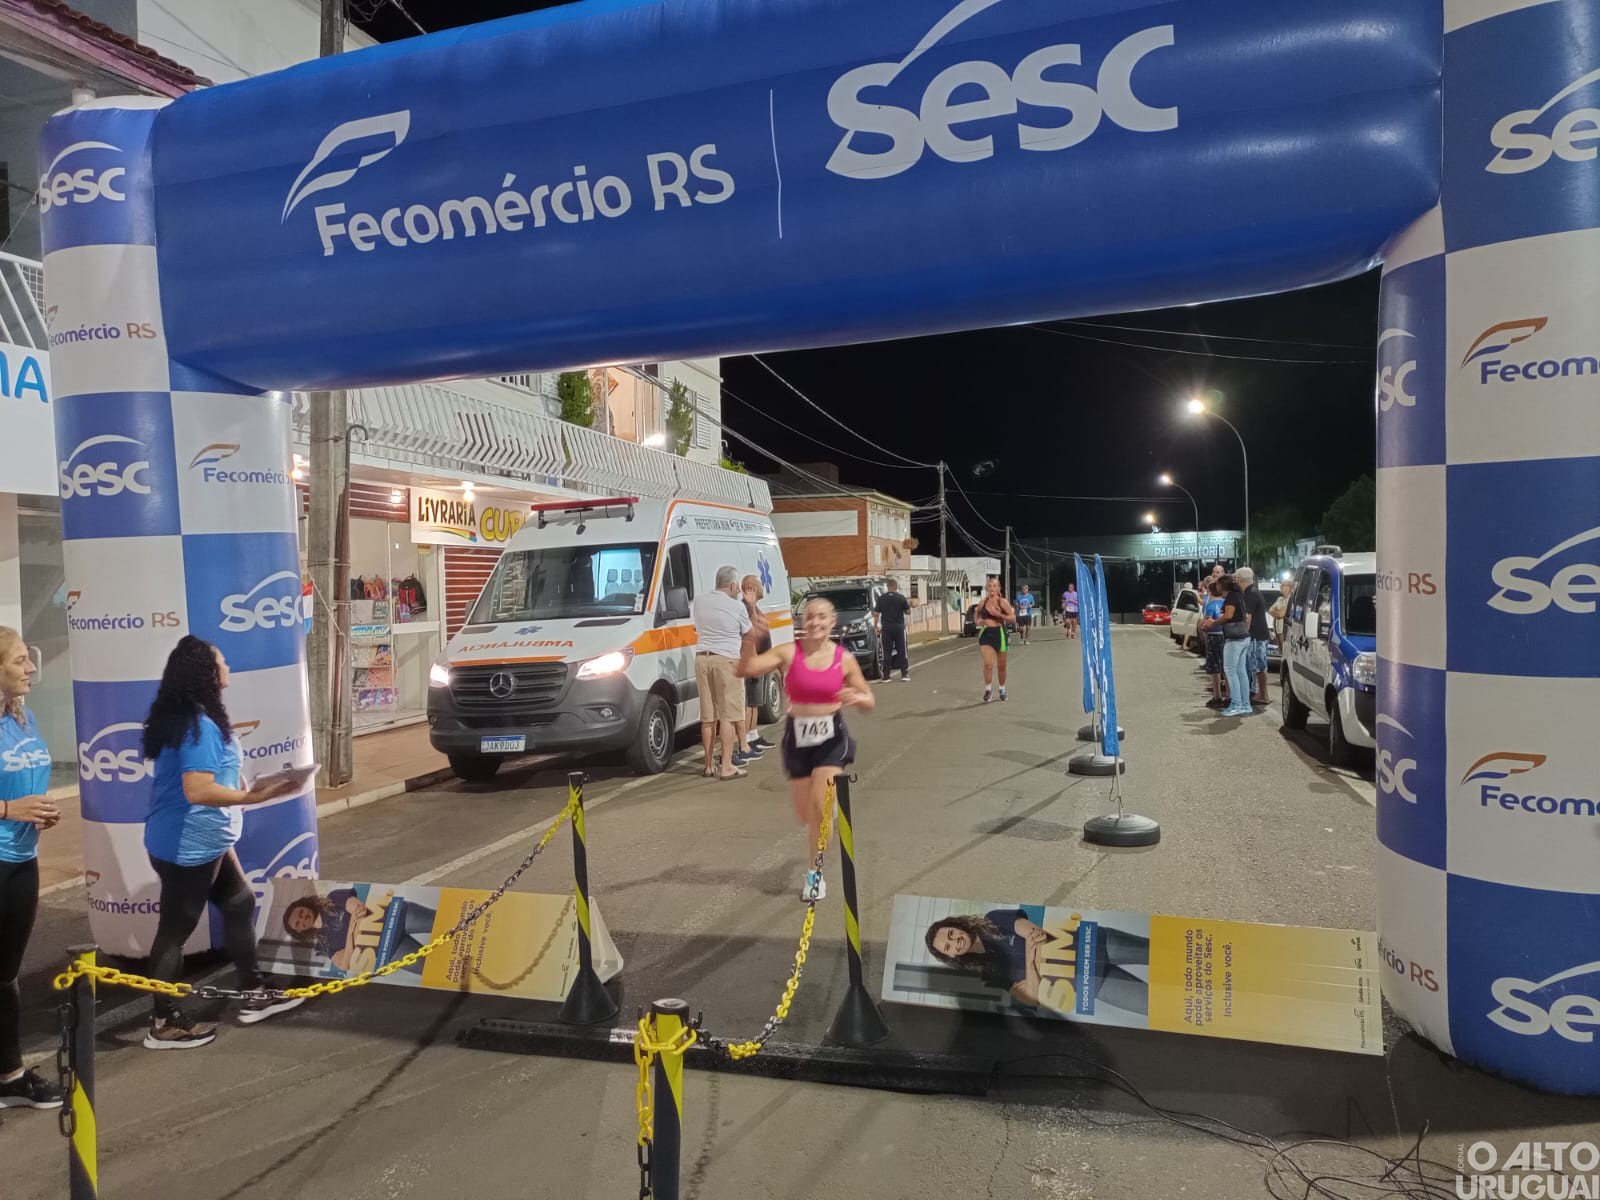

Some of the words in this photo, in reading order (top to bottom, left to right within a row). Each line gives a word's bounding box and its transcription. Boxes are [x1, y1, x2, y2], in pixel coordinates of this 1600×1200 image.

[825, 4, 1178, 179] Sesc
[314, 165, 631, 256] Fecomércio
[647, 144, 735, 210] RS
[49, 323, 121, 347] ecomércio
[126, 322, 157, 340] RS
[59, 448, 151, 499] Sesc
[1408, 572, 1437, 596] RS
[151, 611, 181, 629] RS
[799, 720, 829, 739] 743
[467, 928, 475, 941] do
[1184, 929, 1193, 964] mundo
[1195, 928, 1203, 940] os
[1204, 933, 1213, 959] Sesc.
[1222, 941, 1232, 968] você.
[452, 959, 462, 983] pode
[1184, 967, 1193, 992] todo
[1194, 942, 1203, 995] aproveitar
[1204, 961, 1213, 976] do
[1410, 960, 1440, 993] RS
[1204, 979, 1213, 1023] serviços
[1222, 971, 1232, 1018] Inclusive
[1184, 995, 1194, 1024] Aqui,
[1194, 998, 1203, 1027] pode
